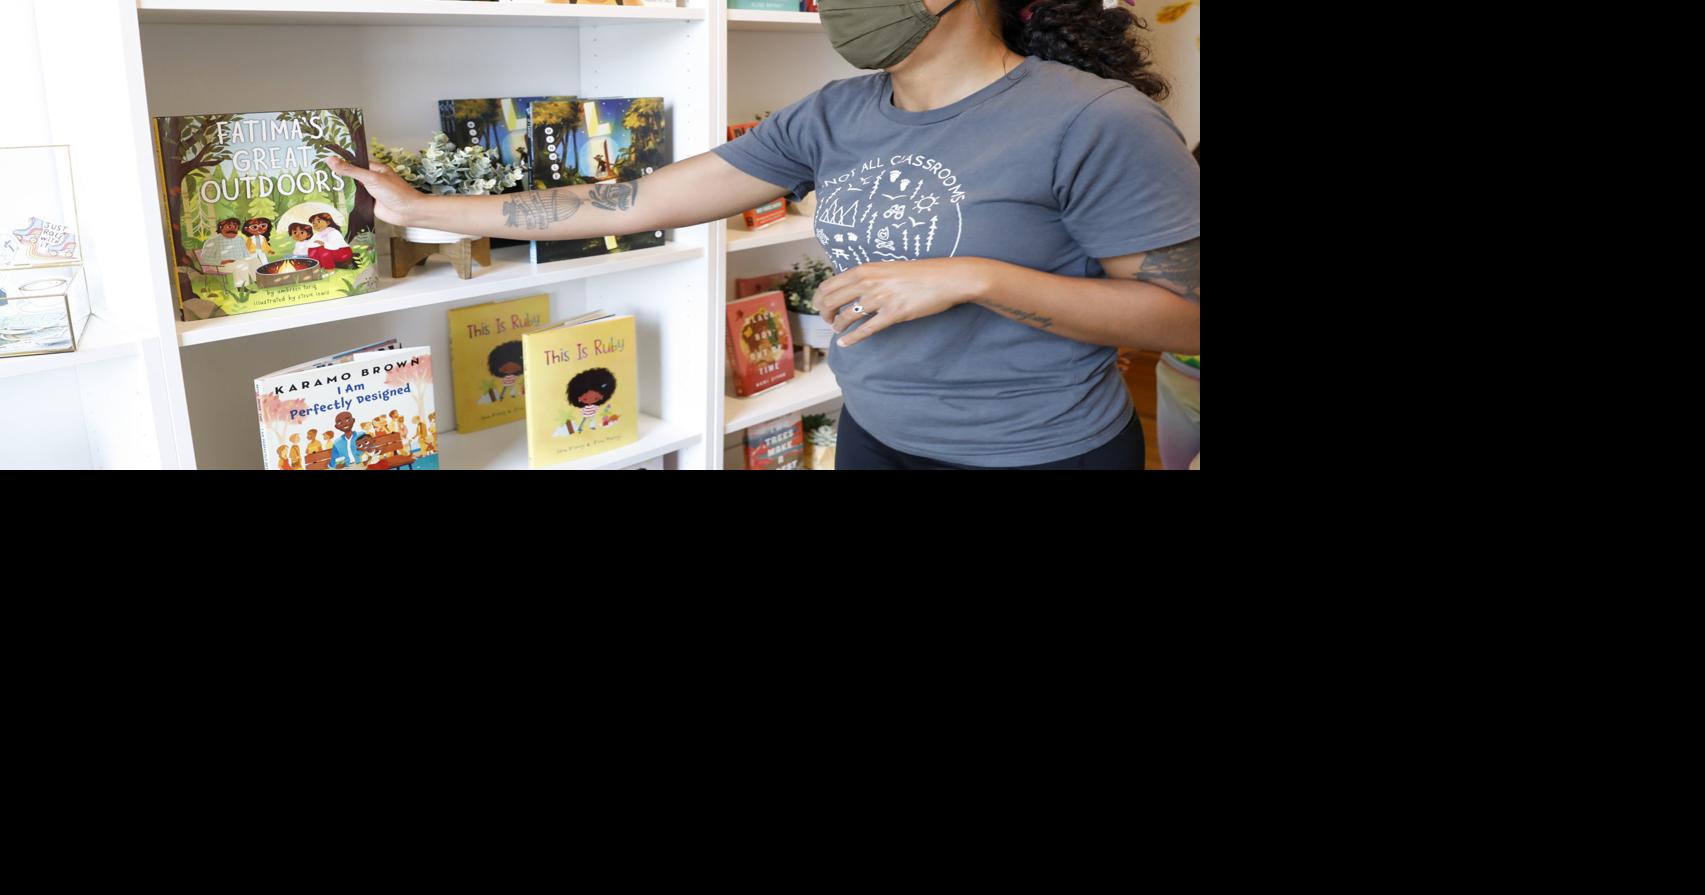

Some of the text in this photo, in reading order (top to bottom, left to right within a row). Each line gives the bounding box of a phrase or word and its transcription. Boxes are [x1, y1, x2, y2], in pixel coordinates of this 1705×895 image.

[216, 116, 324, 145] FATIMA'S
[232, 146, 314, 172] GREAT
[824, 168, 857, 187] NOT
[861, 157, 885, 173] ALL
[200, 168, 345, 204] OUTDOORS
[253, 297, 286, 306] illustrated
[266, 289, 275, 297] by
[467, 314, 541, 339] This Is Ruby
[544, 337, 625, 366] This Is Ruby
[275, 357, 420, 395] KARAMO BROWN
[759, 362, 781, 376] TIME
[290, 383, 411, 420] Perfectly Designed
[337, 382, 365, 395] I Am
